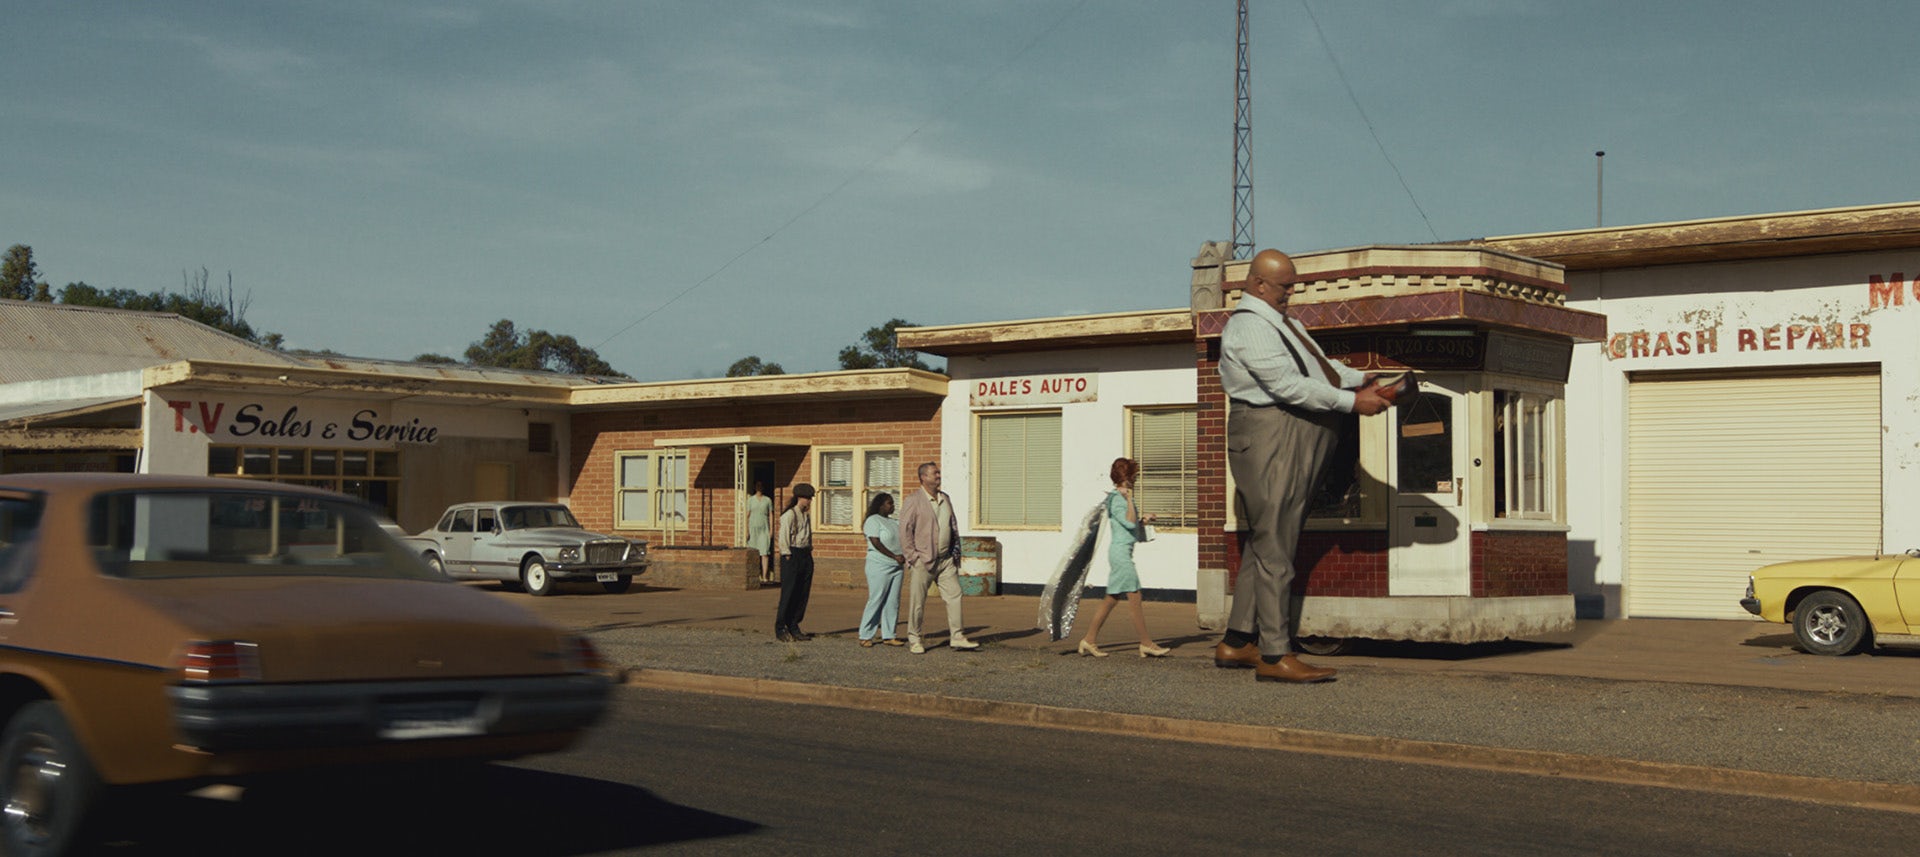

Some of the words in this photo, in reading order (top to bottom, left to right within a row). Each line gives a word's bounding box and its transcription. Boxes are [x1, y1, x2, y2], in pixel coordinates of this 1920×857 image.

[1385, 338, 1422, 355] ENZO
[1438, 339, 1474, 358] SONS
[1608, 328, 1718, 359] CRASH
[1738, 323, 1871, 353] REPAIR
[978, 380, 1031, 396] DALE'S
[1040, 378, 1087, 393] AUTO
[168, 400, 224, 433] T.V
[229, 403, 311, 438] Sales
[347, 409, 438, 443] Service
